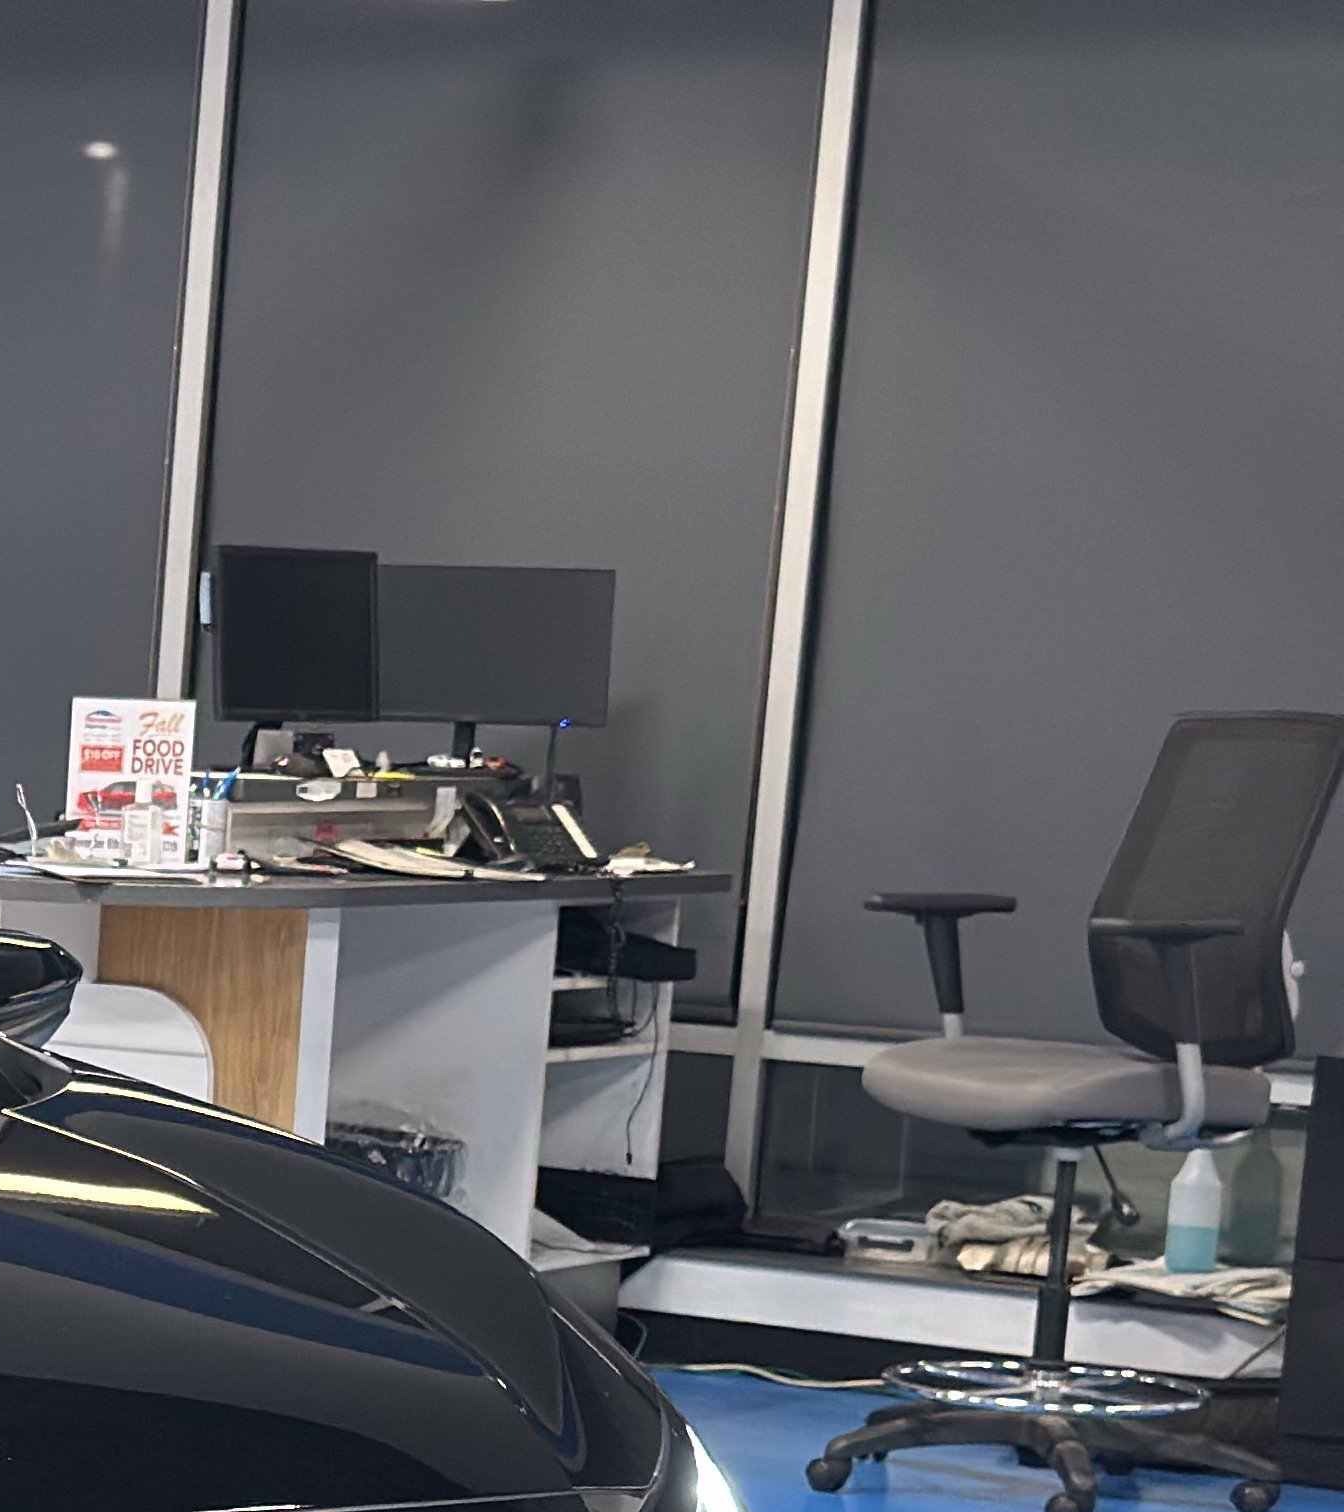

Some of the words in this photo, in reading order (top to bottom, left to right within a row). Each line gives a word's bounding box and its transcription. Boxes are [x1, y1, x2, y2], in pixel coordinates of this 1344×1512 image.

[139, 711, 185, 736] Fall
[133, 739, 185, 758] FOOD
[132, 757, 184, 775] DRIVE
